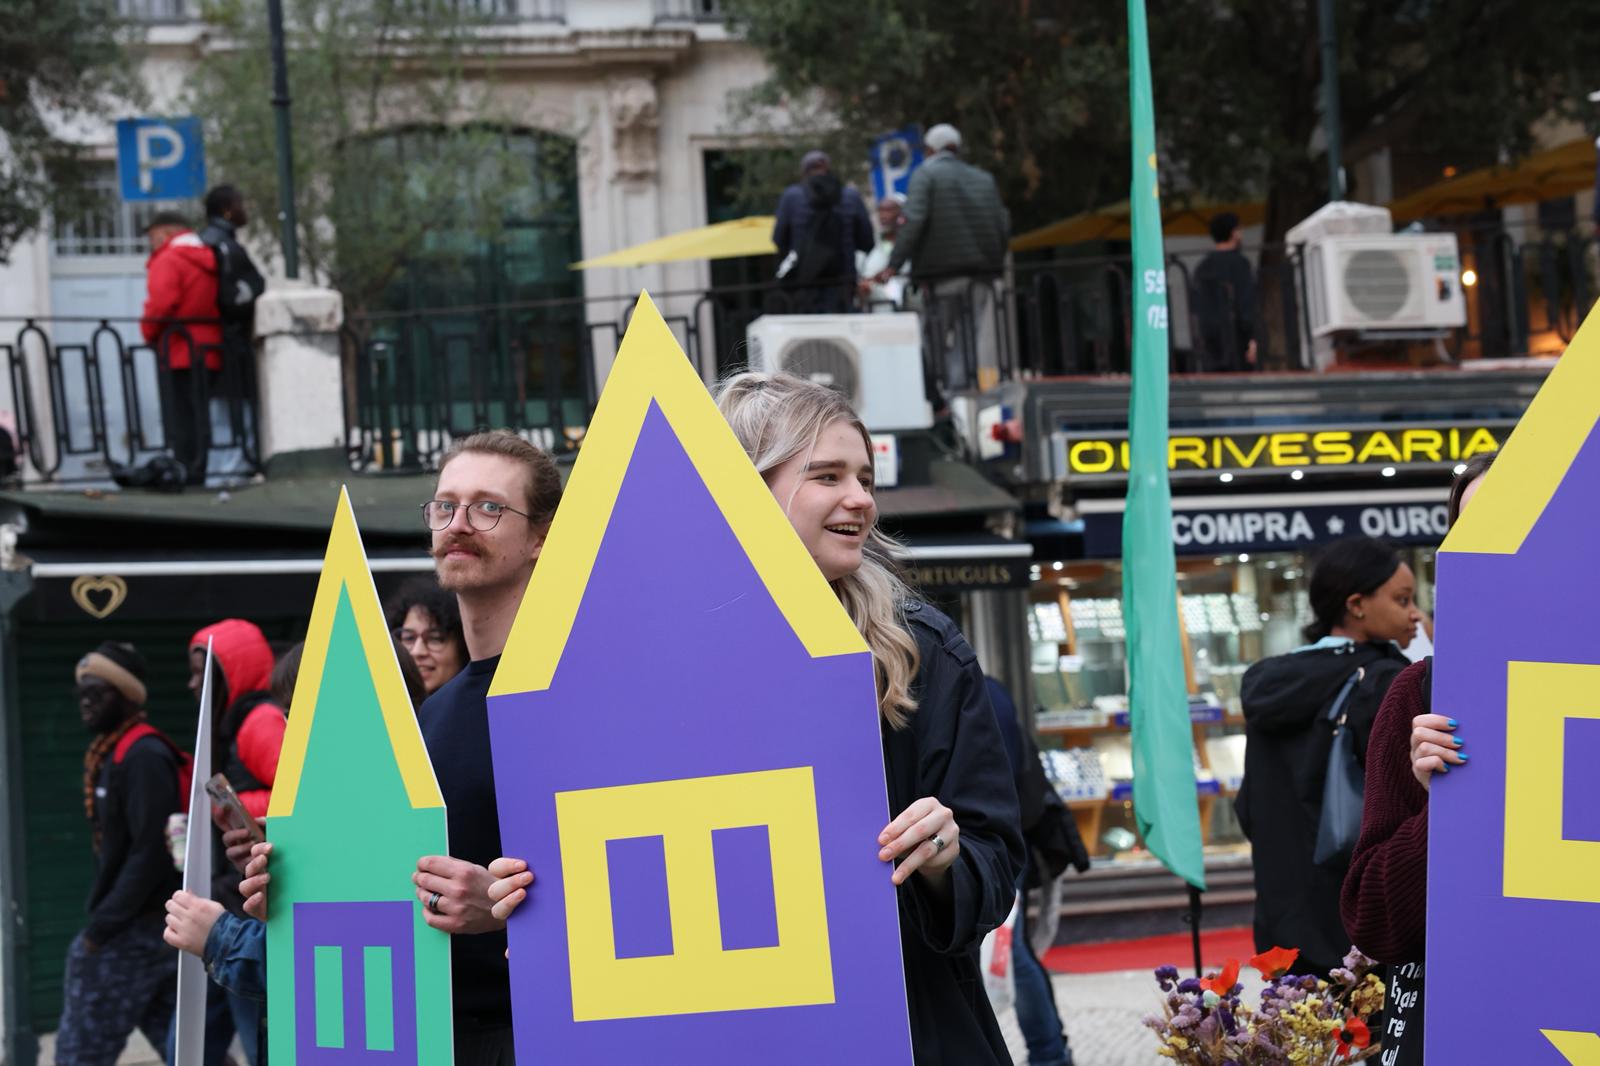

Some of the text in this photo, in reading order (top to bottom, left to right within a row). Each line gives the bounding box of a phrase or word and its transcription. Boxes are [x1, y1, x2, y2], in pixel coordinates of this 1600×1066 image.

[136, 128, 184, 193] P
[880, 138, 912, 200] P
[1171, 511, 1315, 545] COMPRA
